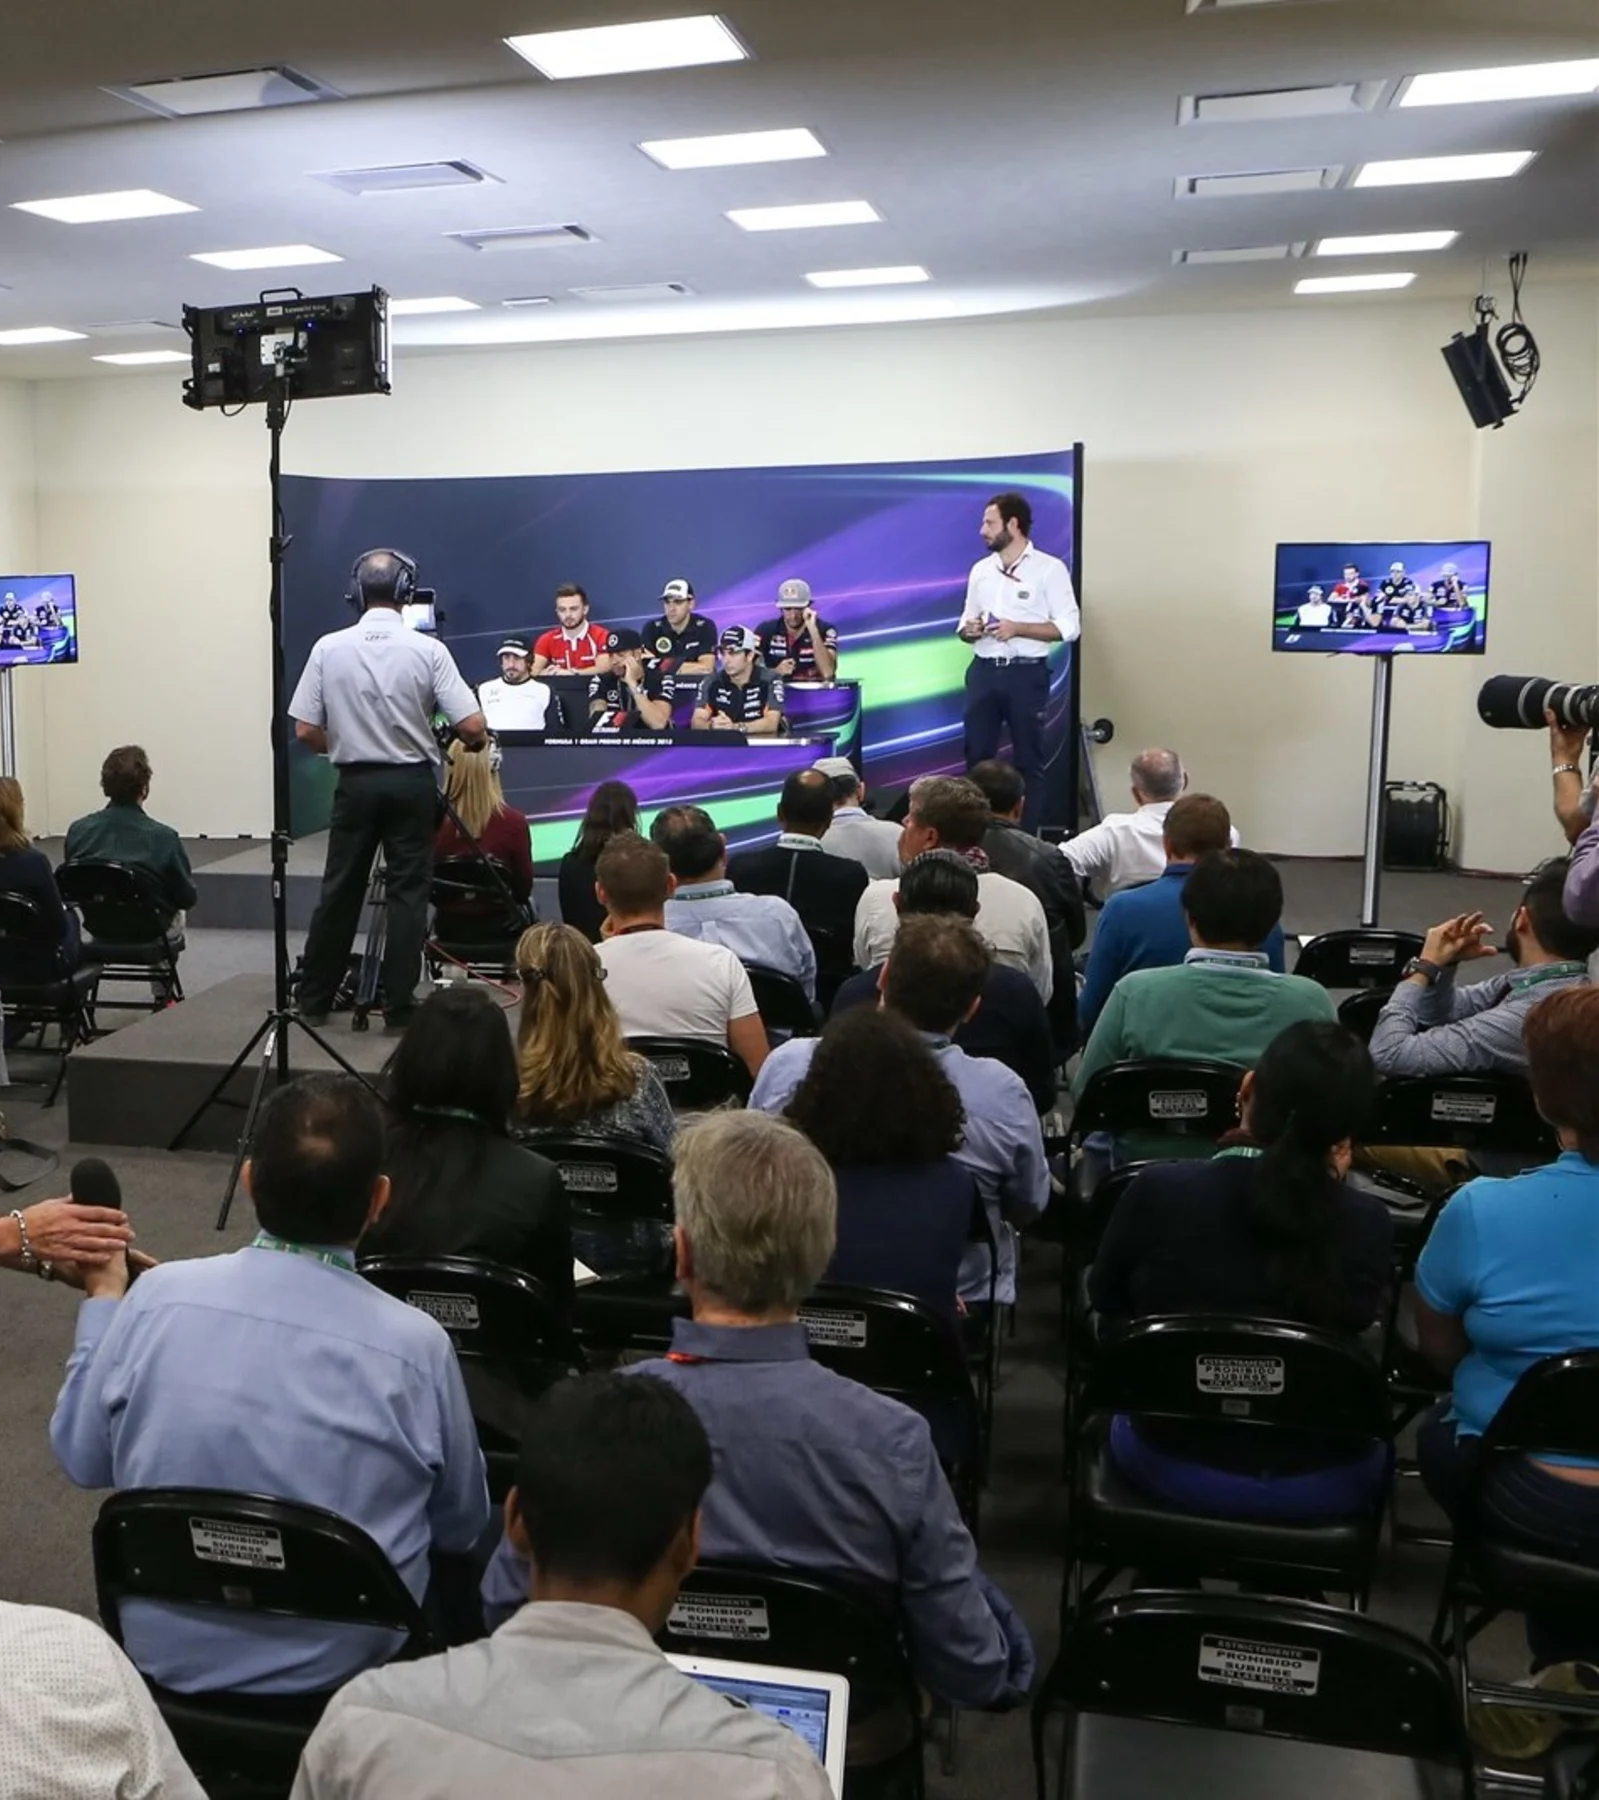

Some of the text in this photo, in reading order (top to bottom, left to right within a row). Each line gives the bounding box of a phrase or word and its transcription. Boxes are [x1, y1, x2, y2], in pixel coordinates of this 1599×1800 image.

[633, 736, 656, 745] MÉXICO
[1205, 1366, 1276, 1375] PROHIBIDO
[1214, 1373, 1268, 1381] SUBIRSE
[203, 1531, 269, 1546] PROHIBIDO
[212, 1541, 262, 1552] SUBIRSE
[679, 1606, 752, 1616] PROHIBIDO
[687, 1615, 746, 1624] SUBIRSE
[1217, 1639, 1303, 1658] ESTRICTAMENTE
[1216, 1649, 1302, 1669] PROHIBIDO
[1225, 1661, 1292, 1677] SUBIRSE
